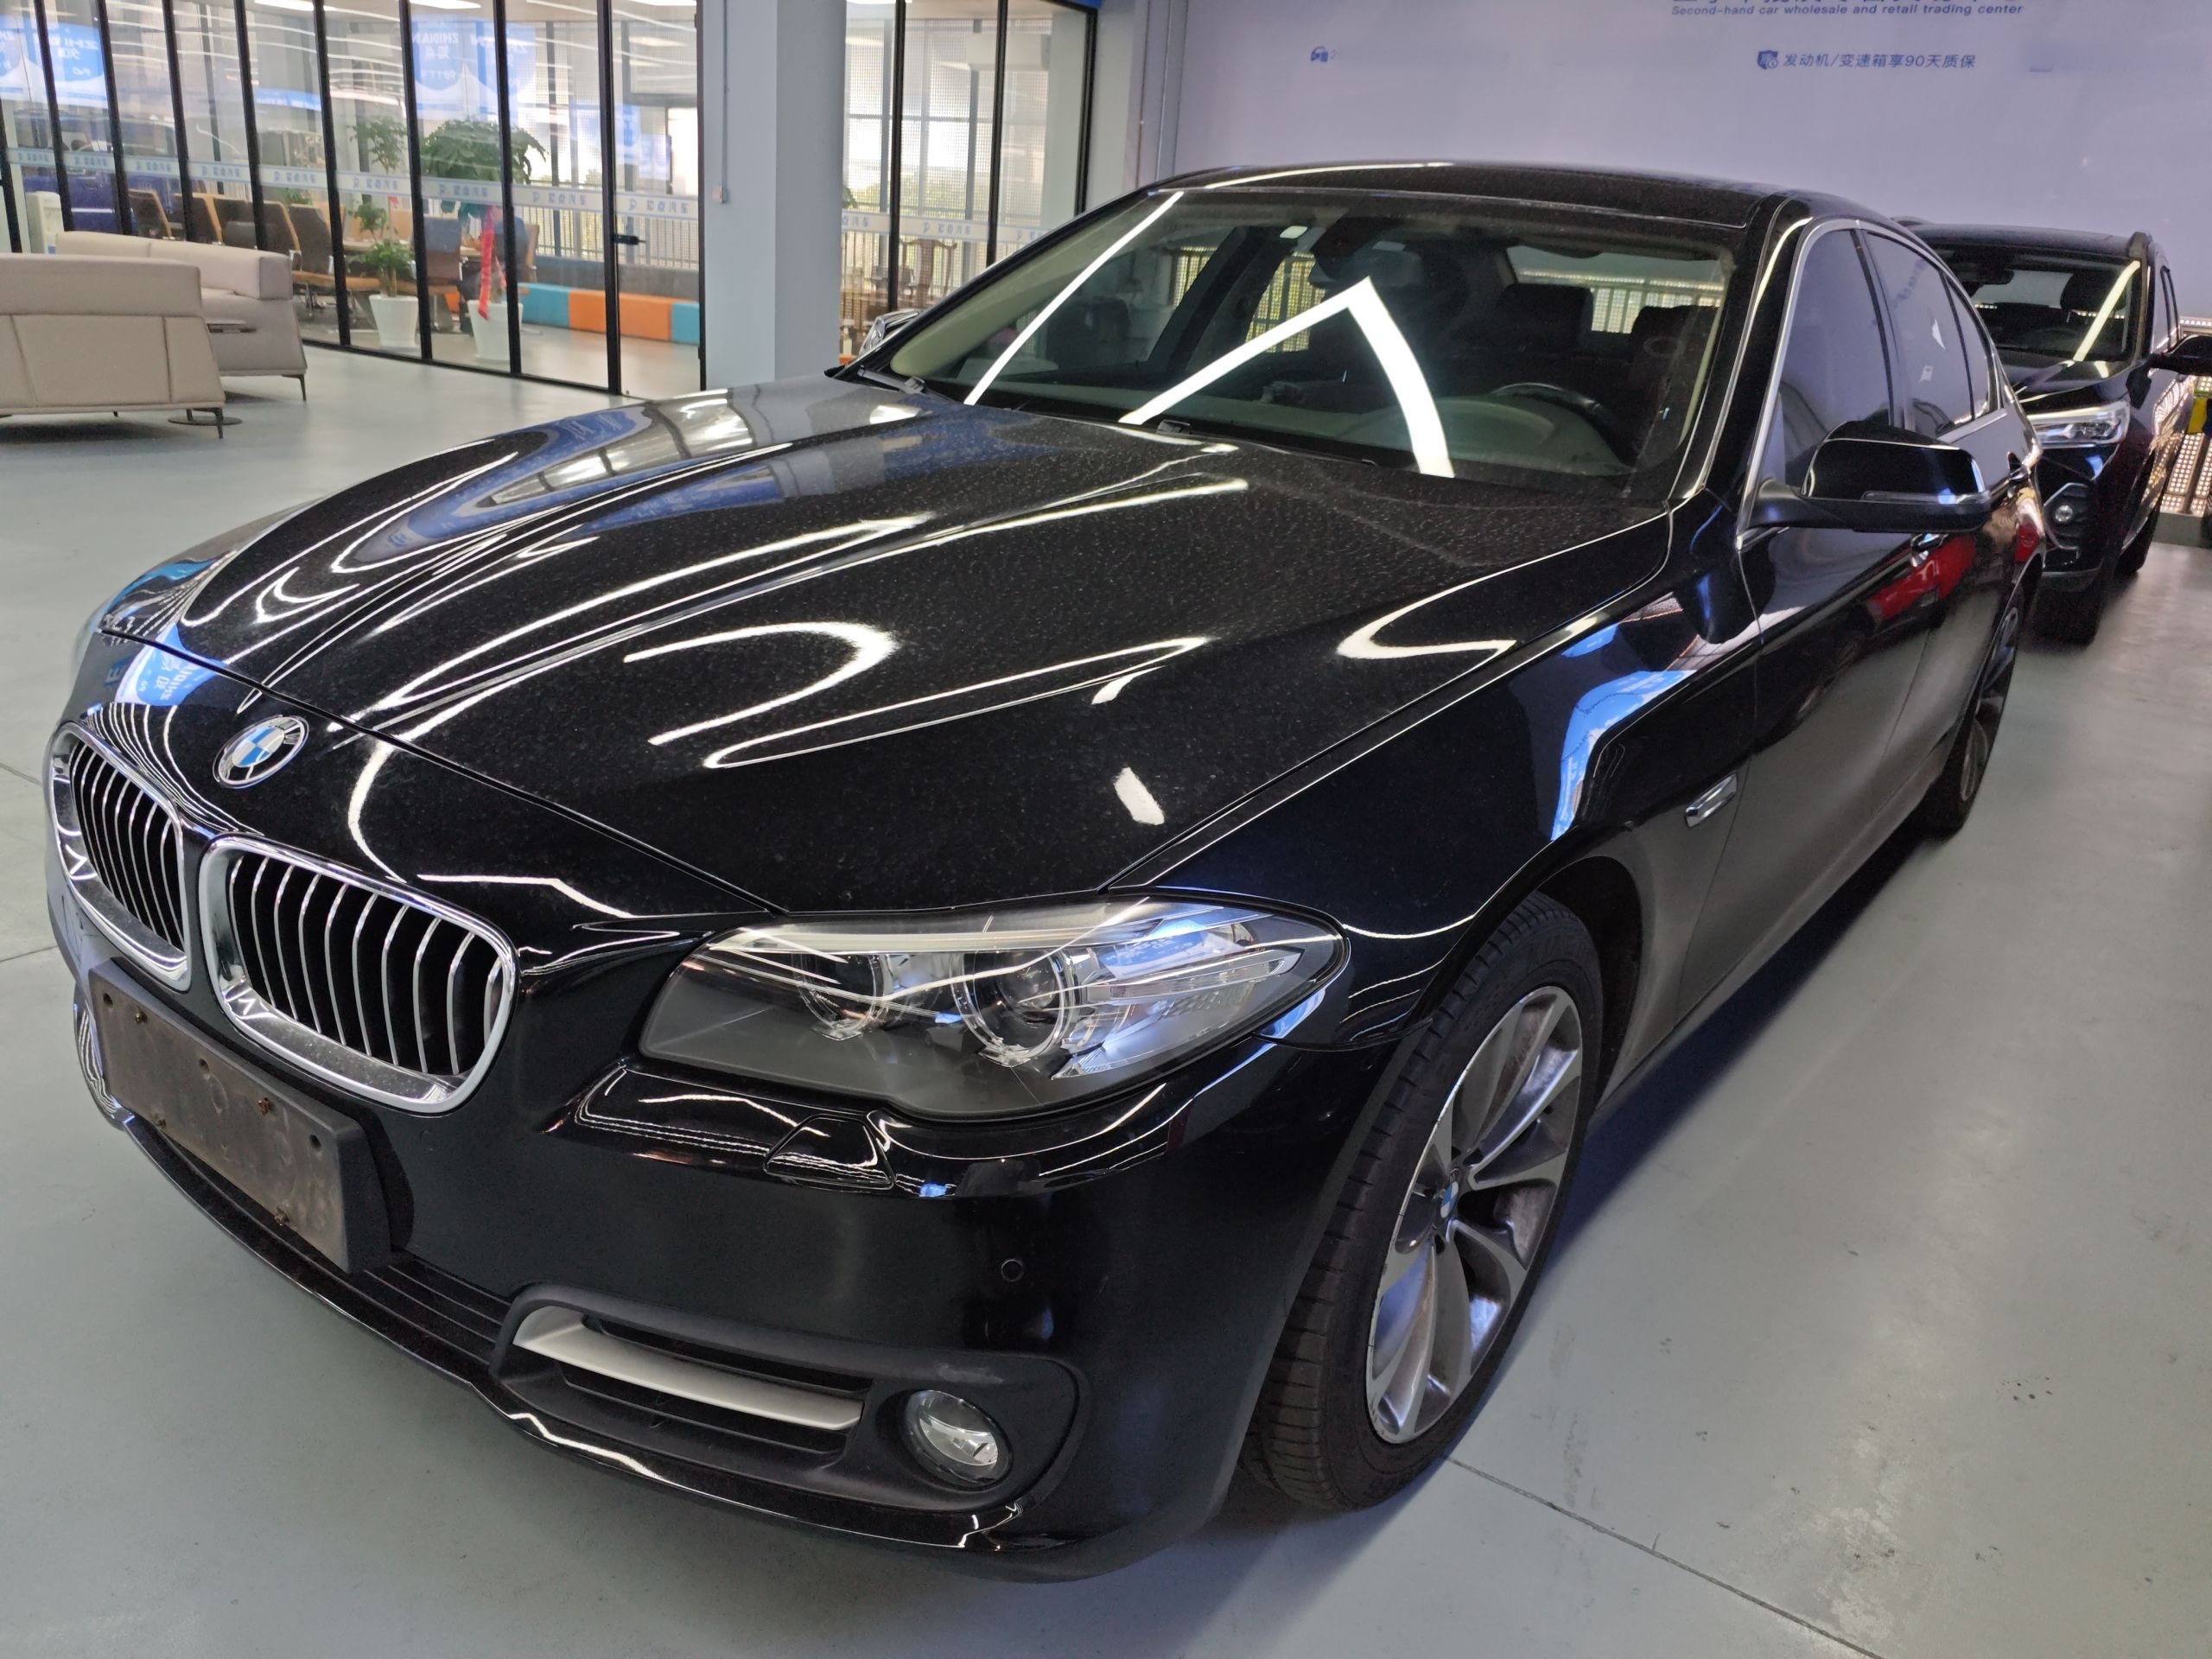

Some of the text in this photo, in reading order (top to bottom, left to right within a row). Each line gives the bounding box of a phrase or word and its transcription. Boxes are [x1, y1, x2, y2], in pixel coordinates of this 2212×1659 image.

[1672, 5, 1754, 16] Second-hand
[1783, 4, 1847, 15] wholesale
[1853, 4, 1877, 14] and
[1882, 4, 1917, 14] retail
[1923, 4, 1972, 16] trading
[1978, 4, 2024, 14] center
[1783, 53, 1976, 69] 发动机/变速箱享90天质保
